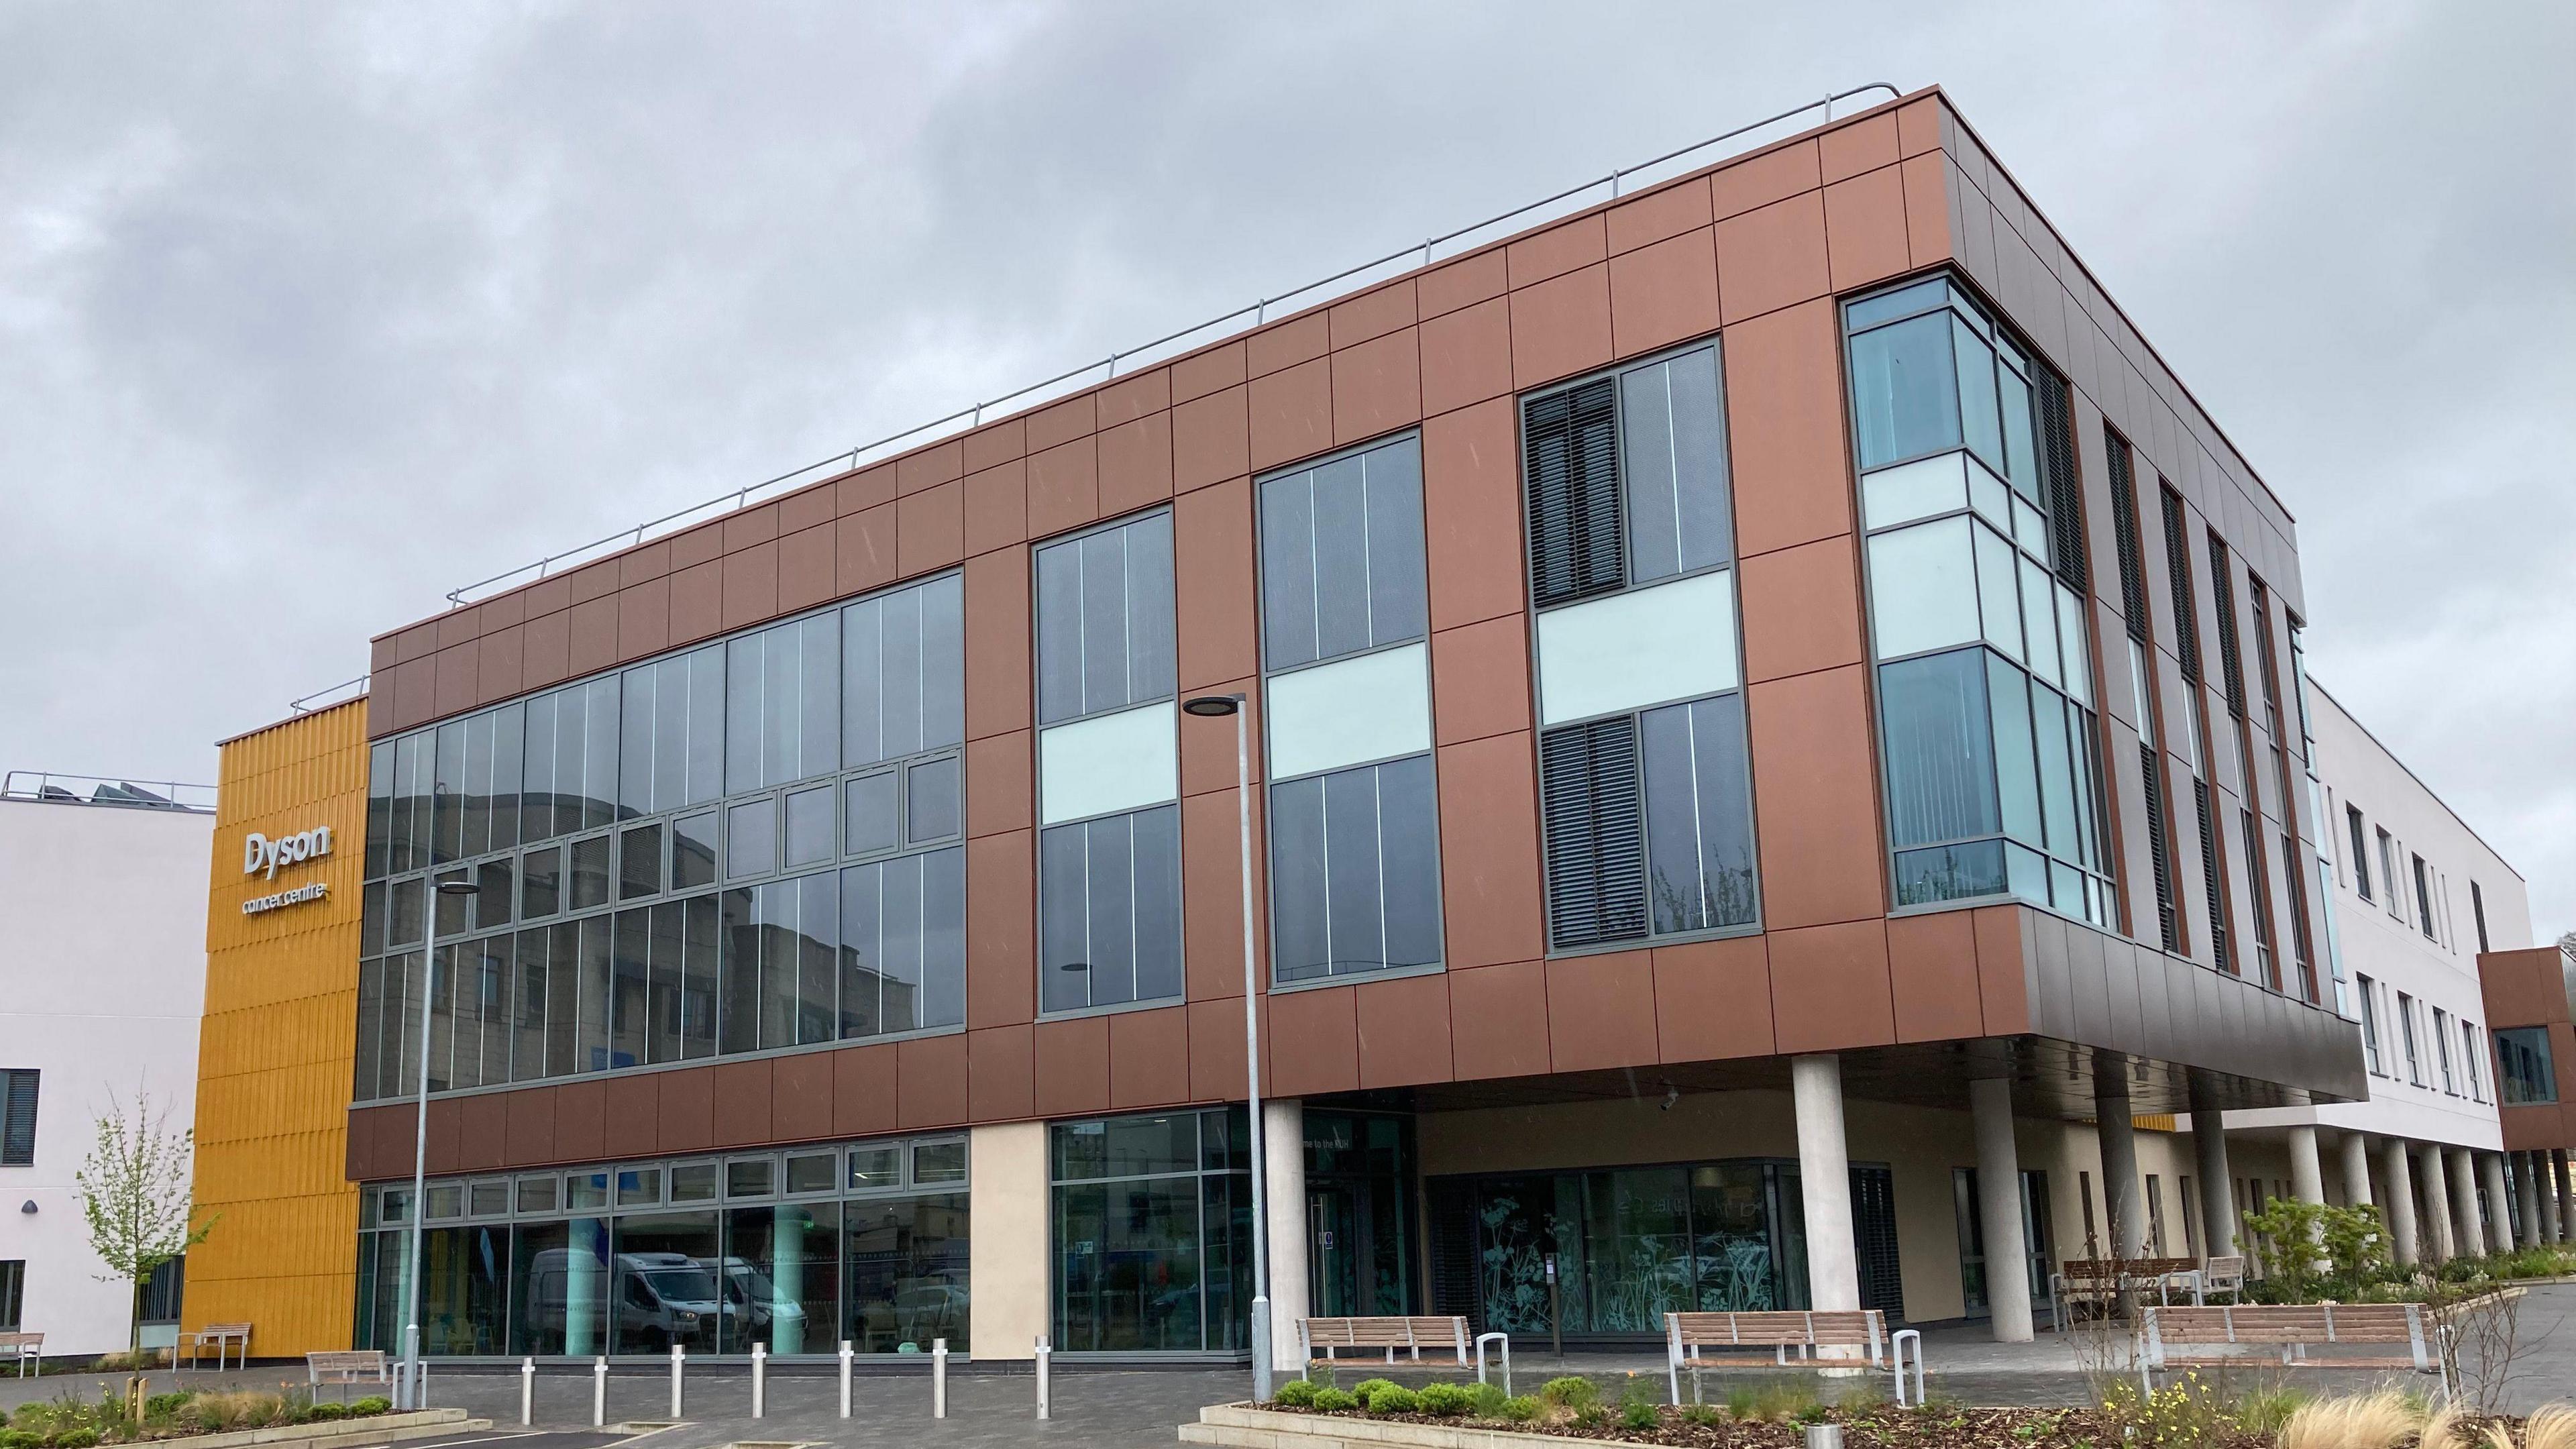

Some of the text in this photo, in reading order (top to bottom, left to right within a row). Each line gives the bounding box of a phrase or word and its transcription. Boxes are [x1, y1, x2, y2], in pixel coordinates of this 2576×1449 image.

[244, 826, 332, 880] Dyson
[243, 881, 327, 914] cancer centre
[1314, 1138, 1321, 1148] to
[1322, 1139, 1334, 1148] the
